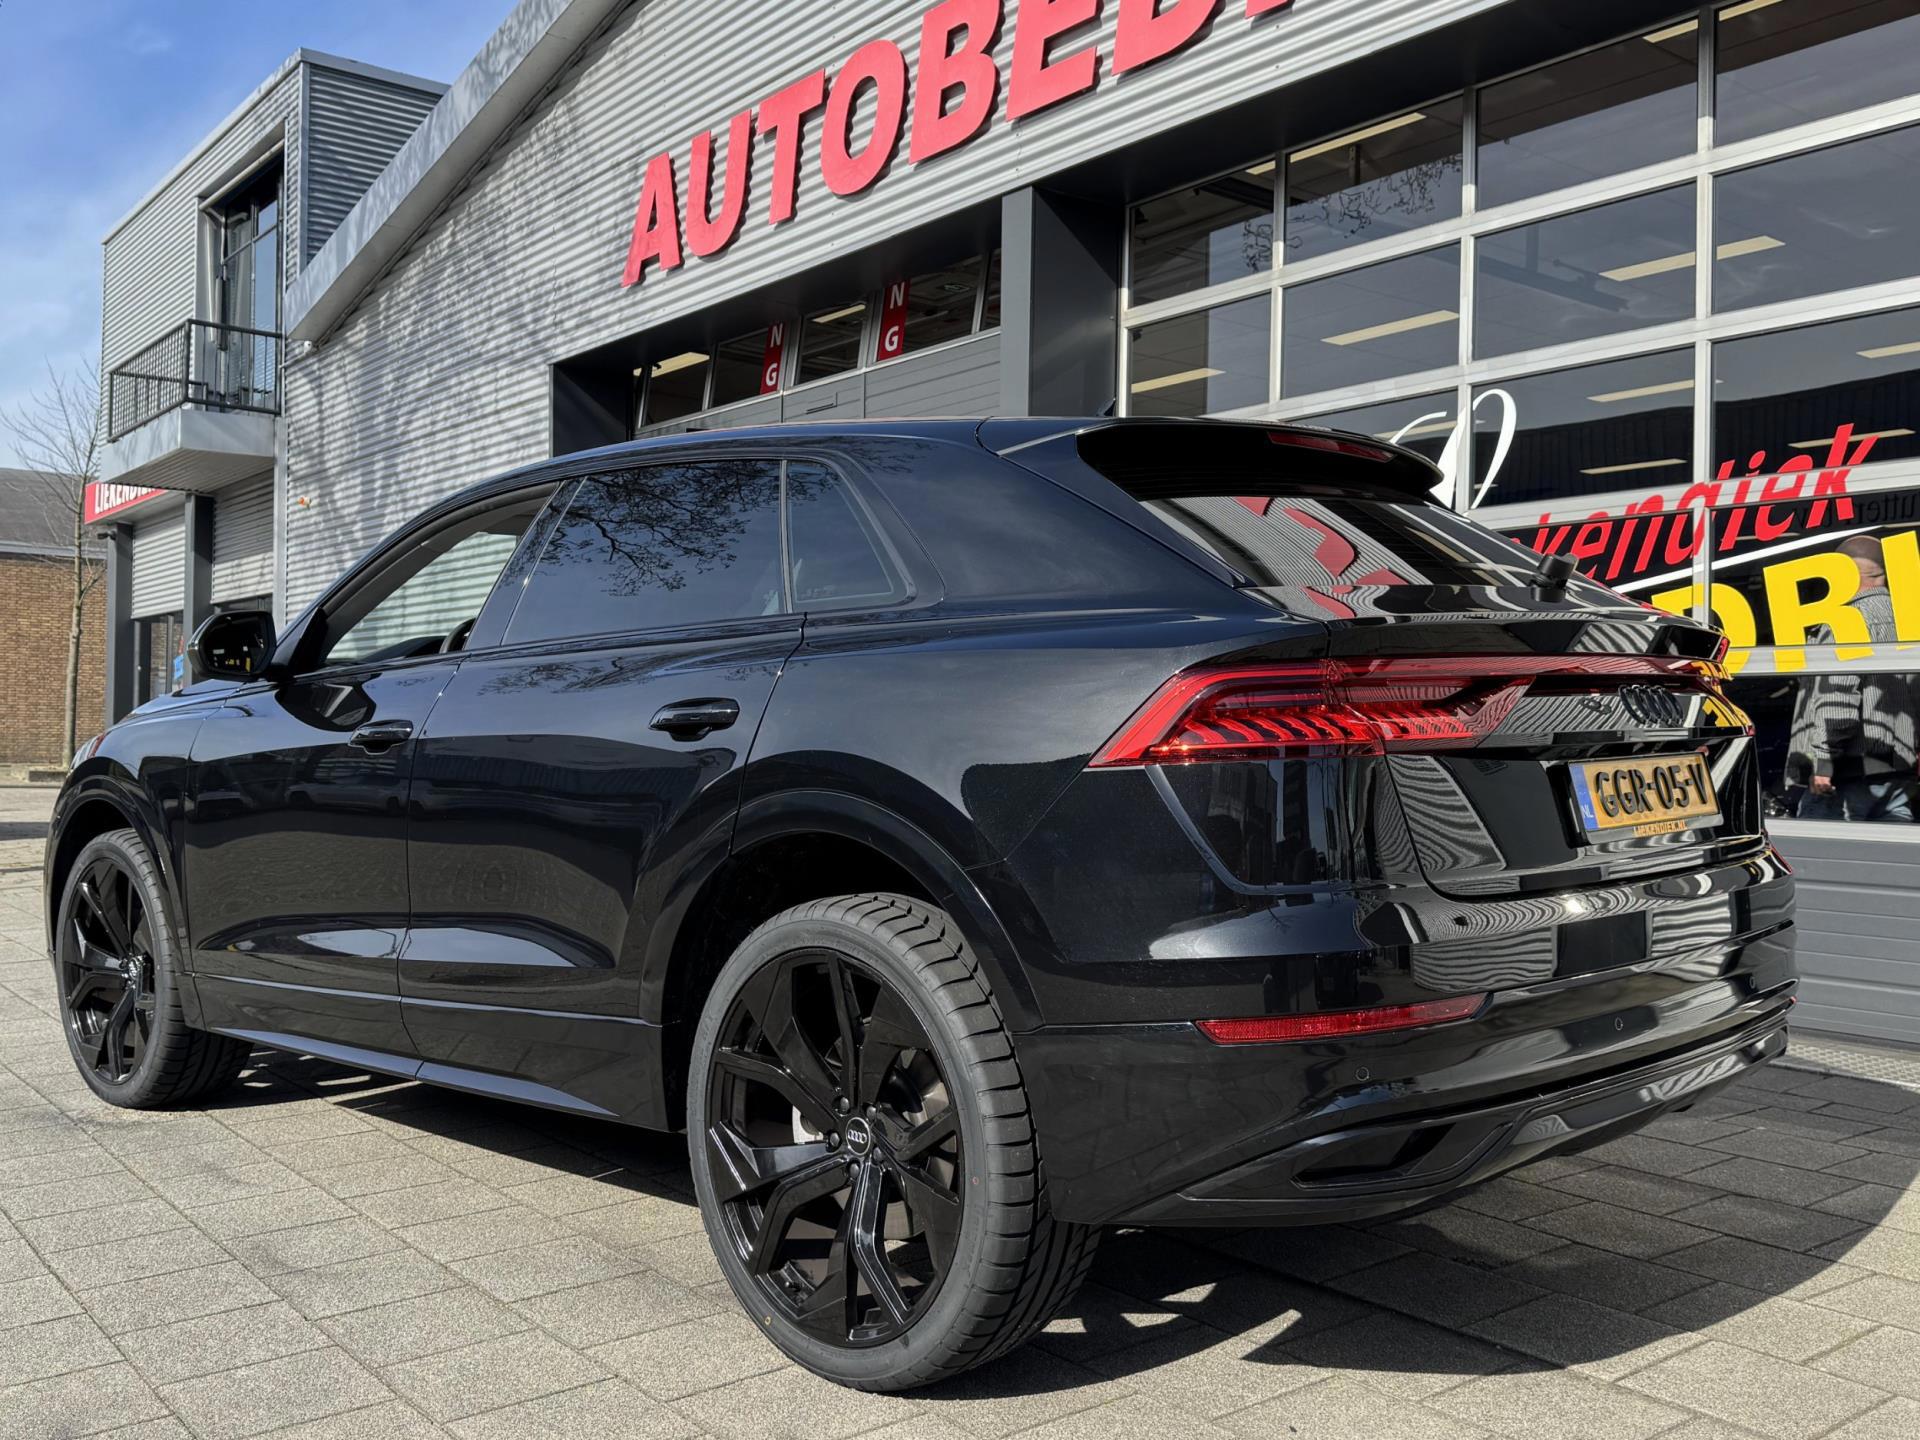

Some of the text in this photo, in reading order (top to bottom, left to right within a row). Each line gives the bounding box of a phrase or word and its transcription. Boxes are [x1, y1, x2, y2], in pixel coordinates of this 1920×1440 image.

[621, 0, 1294, 288] AUTOBE
[94, 483, 157, 514] LIEKEND
[1511, 423, 1880, 581] kendiek
[1581, 804, 1594, 819] NL
[1595, 763, 1707, 818] GGR-05-V
